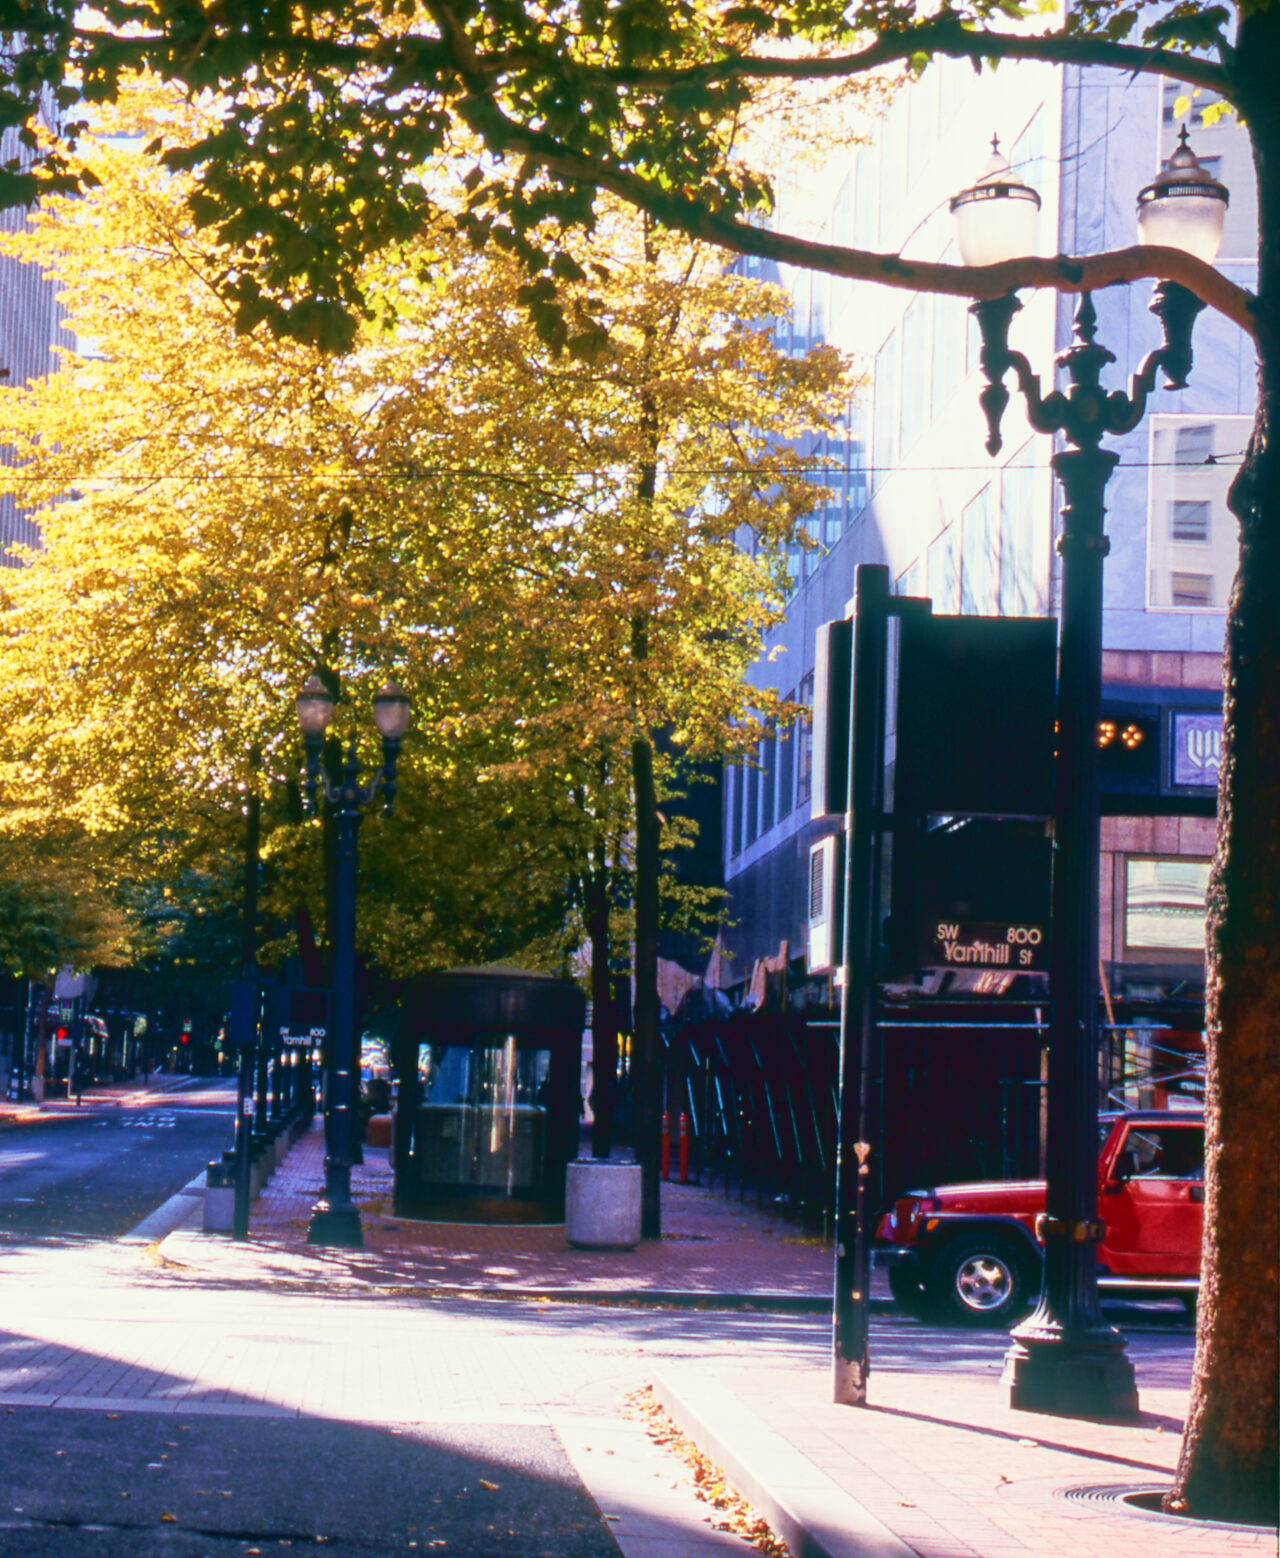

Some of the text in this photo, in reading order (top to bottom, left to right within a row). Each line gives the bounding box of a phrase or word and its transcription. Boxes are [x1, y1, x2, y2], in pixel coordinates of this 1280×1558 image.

[937, 923, 1042, 945] SW 800
[944, 940, 1033, 965] Yamhill St
